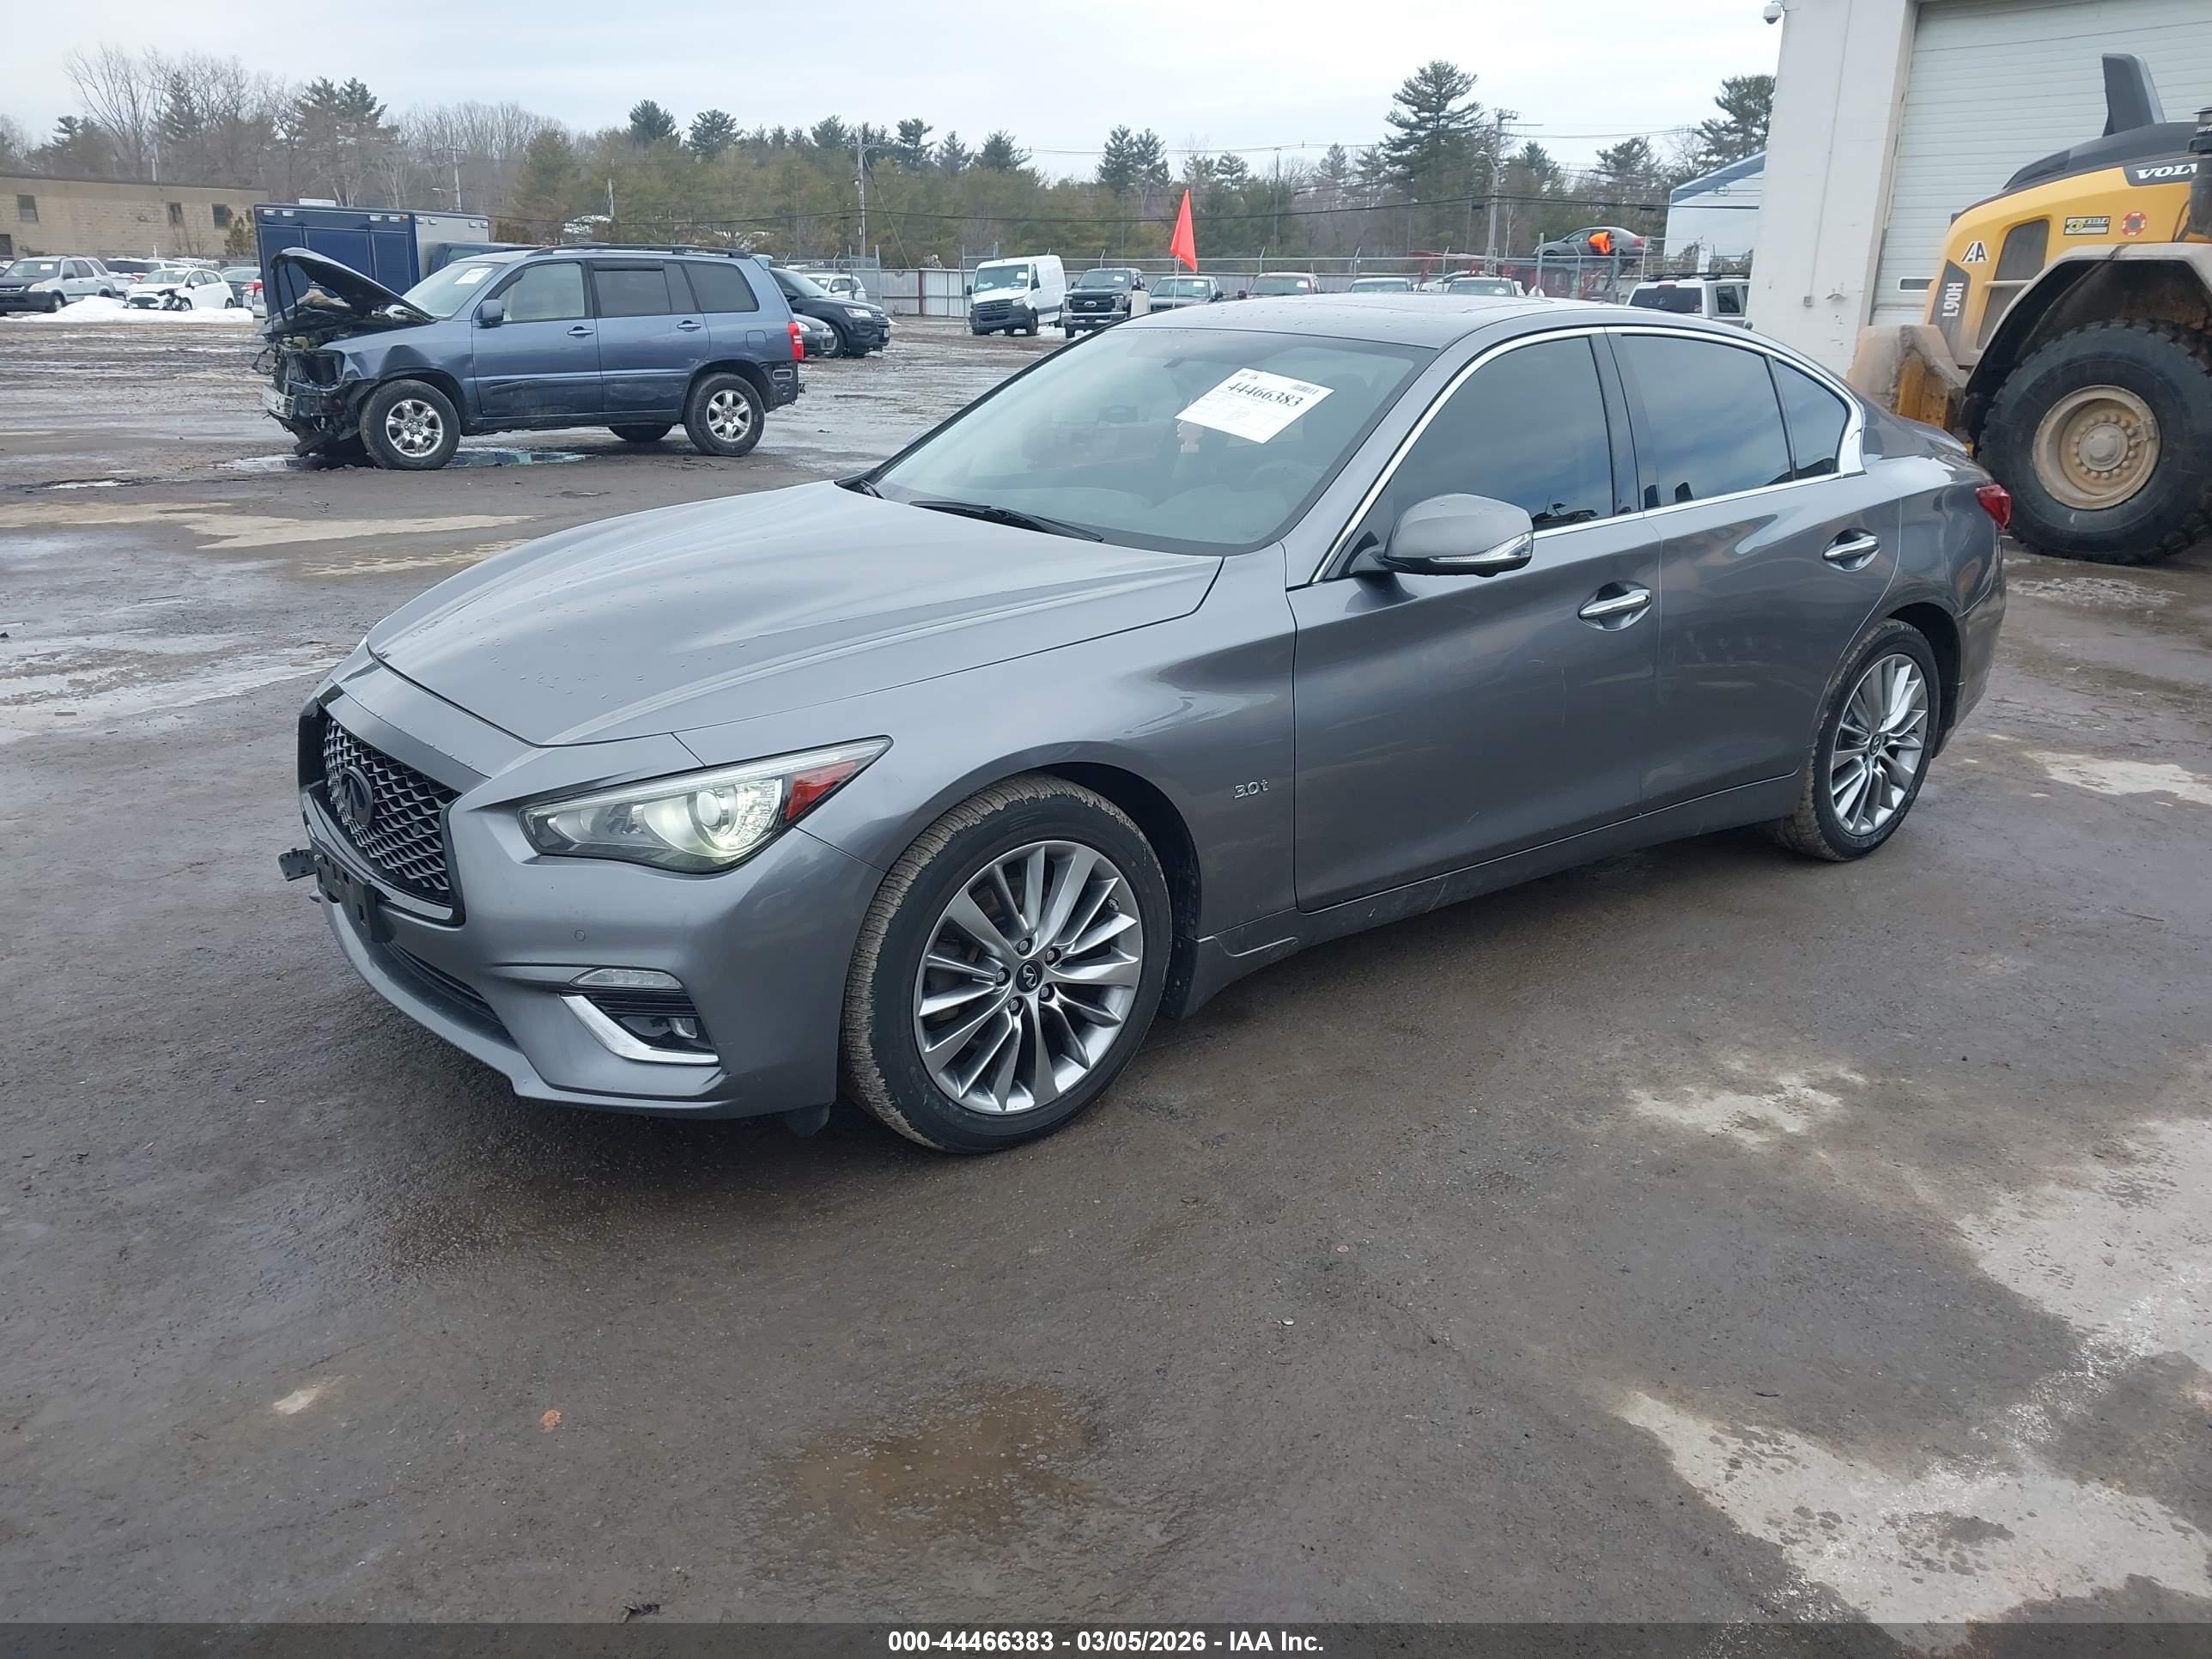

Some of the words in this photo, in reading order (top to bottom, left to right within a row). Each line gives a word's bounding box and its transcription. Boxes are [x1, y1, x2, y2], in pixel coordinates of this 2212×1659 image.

[2136, 163, 2198, 179] VOLV
[1942, 283, 1965, 317] L90H
[1227, 381, 1304, 407] 44466383
